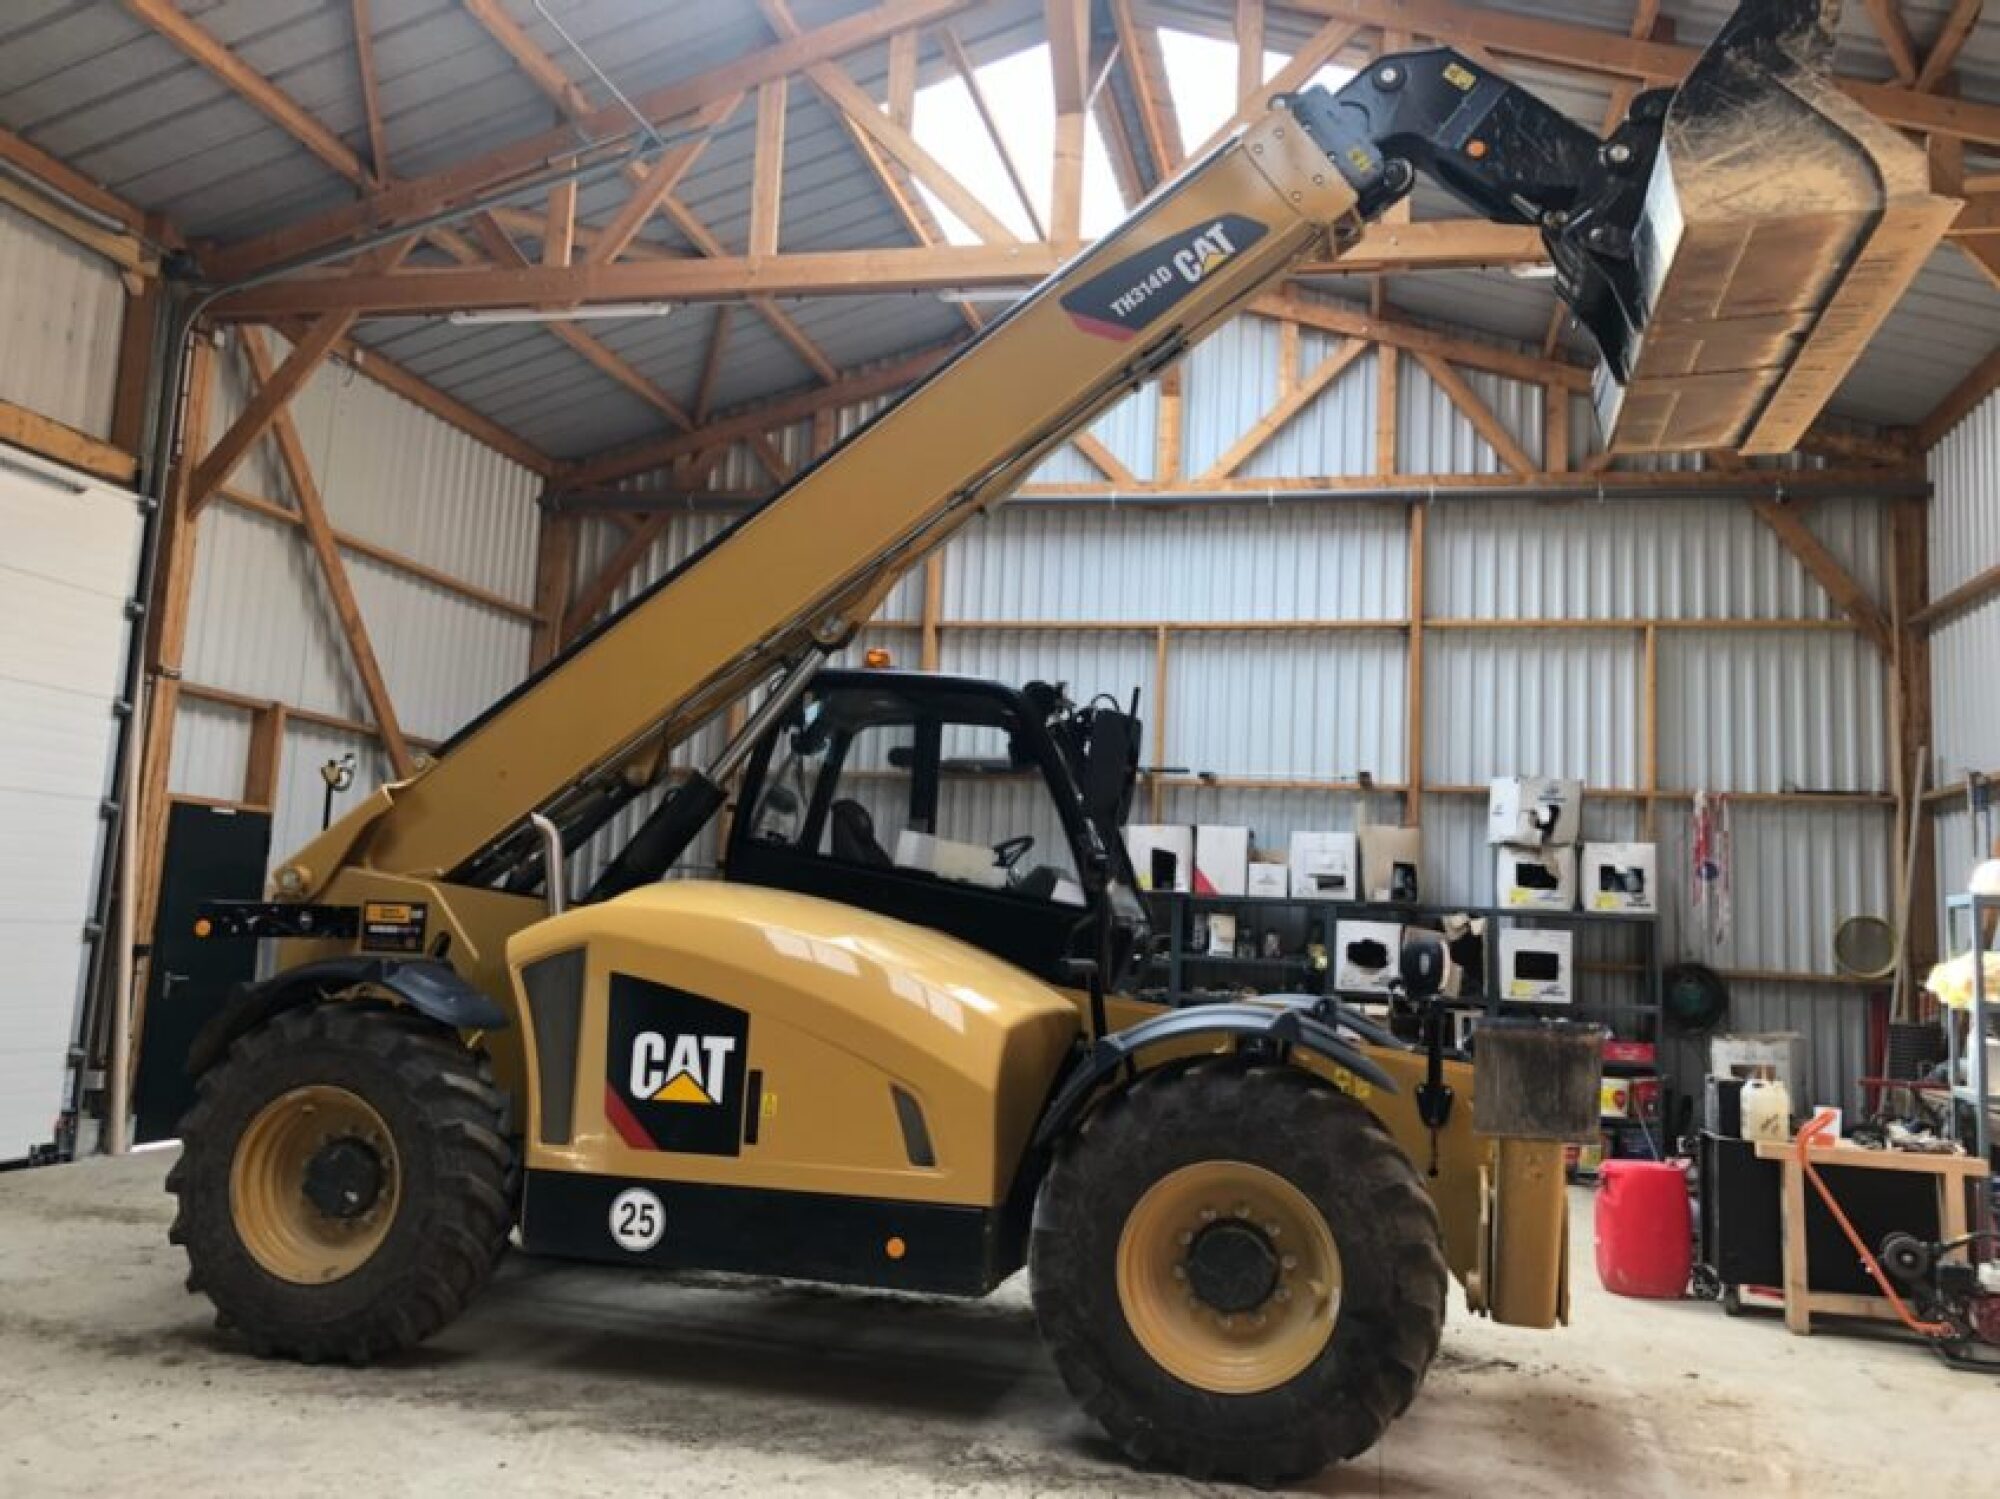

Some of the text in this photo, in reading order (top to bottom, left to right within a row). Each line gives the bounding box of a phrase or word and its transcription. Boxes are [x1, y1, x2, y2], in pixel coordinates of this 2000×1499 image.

[1174, 223, 1236, 282] CAT
[631, 1031, 735, 1104] CAT
[620, 1202, 655, 1237] 25
